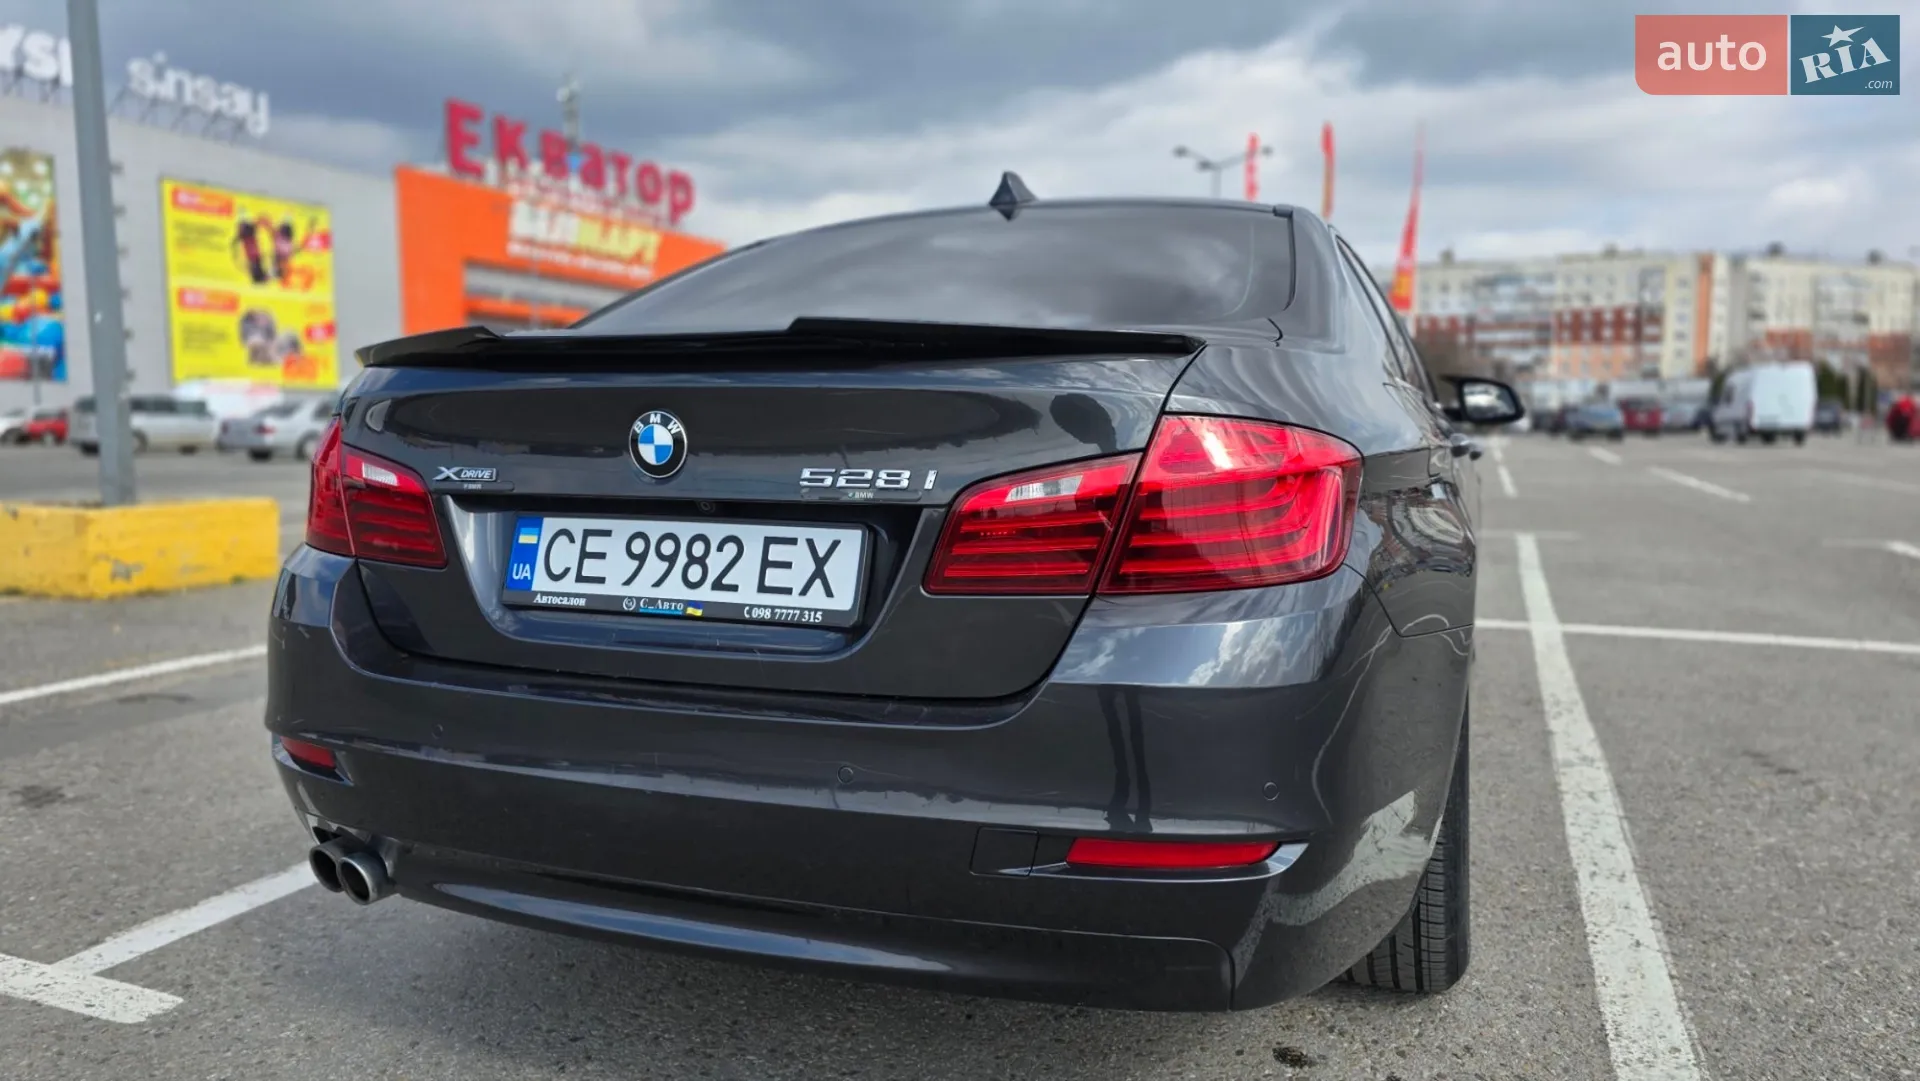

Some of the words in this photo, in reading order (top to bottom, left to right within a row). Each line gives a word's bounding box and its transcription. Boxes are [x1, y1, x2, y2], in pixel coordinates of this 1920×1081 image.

[126, 50, 270, 136] sinsay
[633, 413, 681, 434] BMW
[512, 563, 531, 581] UA
[543, 528, 613, 585] CE
[621, 531, 745, 592] 9982
[757, 536, 842, 598] EX
[533, 593, 586, 607] Автосалон
[751, 607, 771, 620] 098
[773, 608, 800, 621] 7777
[802, 610, 823, 623] 315
